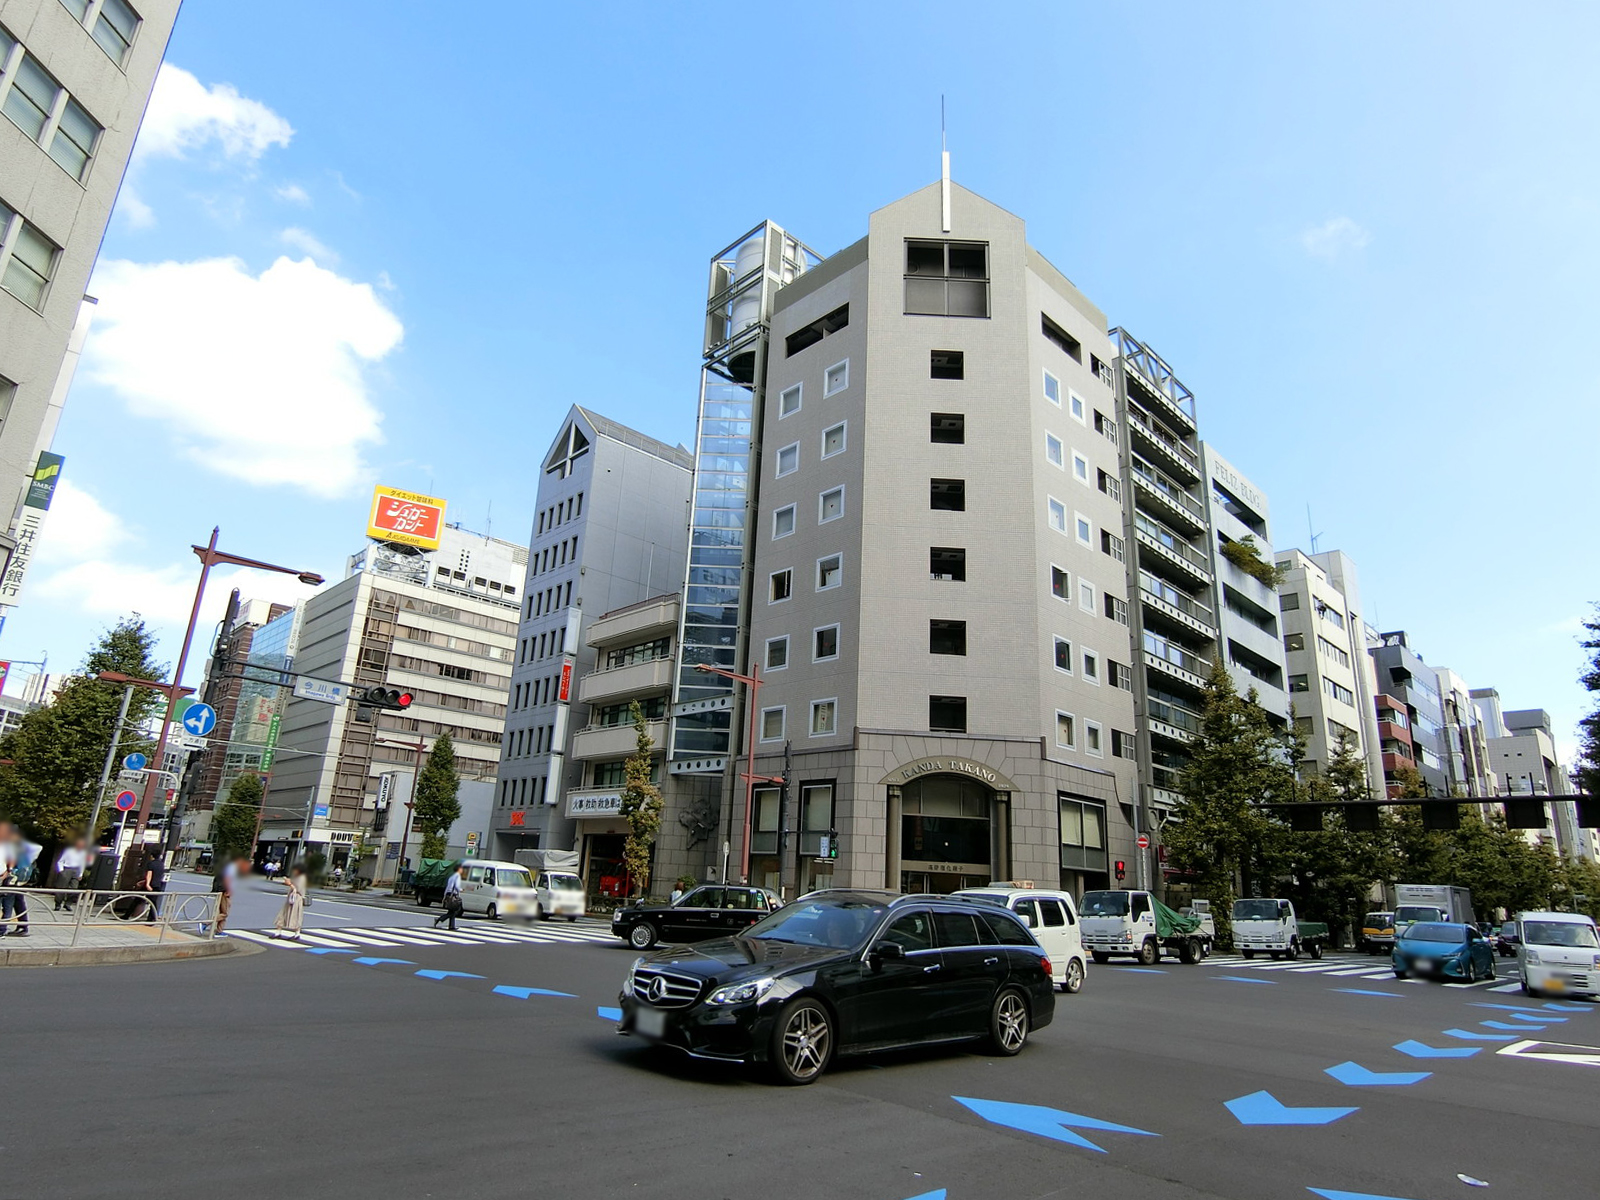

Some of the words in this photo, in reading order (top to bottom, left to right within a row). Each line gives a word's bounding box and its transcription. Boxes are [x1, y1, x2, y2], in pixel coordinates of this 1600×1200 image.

[32, 481, 55, 491] SMBC
[386, 501, 429, 521] シュガー
[2, 514, 41, 597] 三井住友銀行
[901, 761, 942, 780] KANDA
[948, 760, 996, 782] TAKANO
[381, 776, 389, 802] KOKUYO
